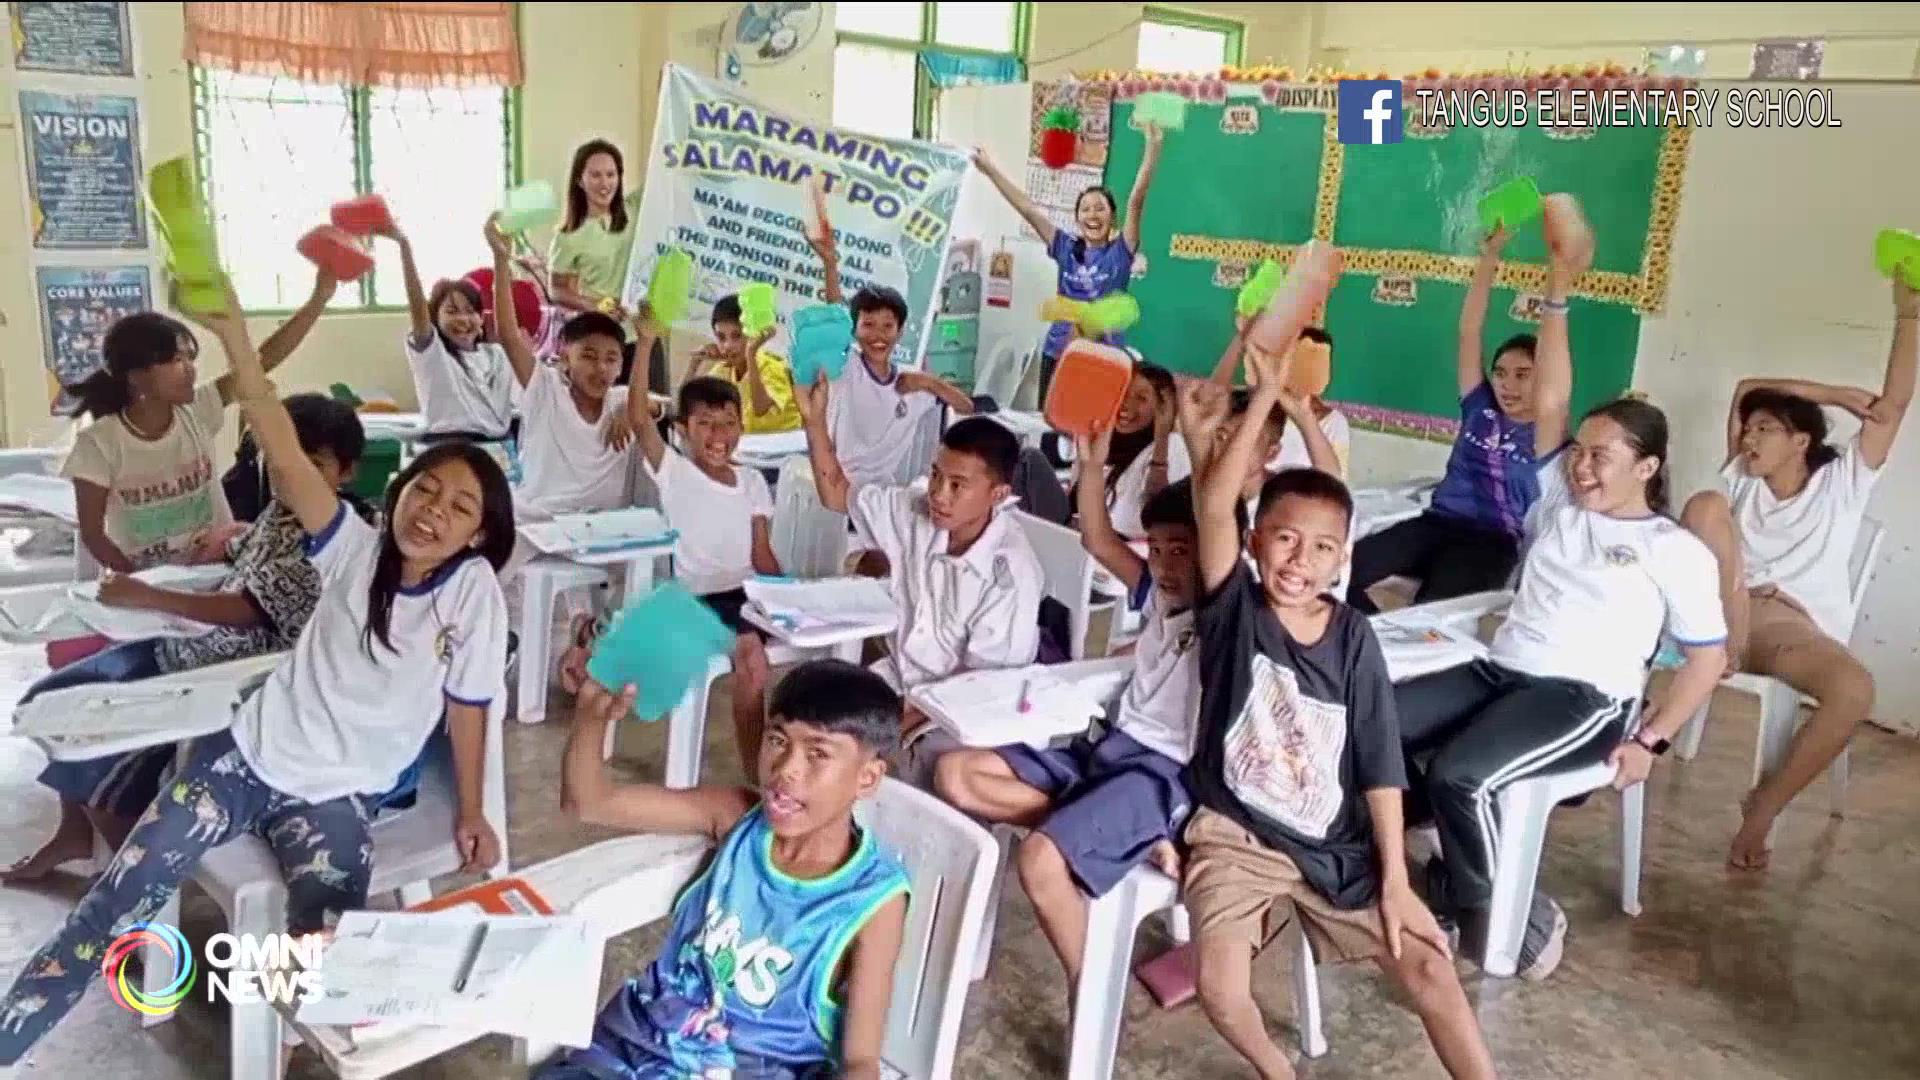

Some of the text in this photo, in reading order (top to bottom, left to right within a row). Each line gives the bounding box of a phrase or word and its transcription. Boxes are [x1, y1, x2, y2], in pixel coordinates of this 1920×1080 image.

[33, 114, 128, 138] VISION
[694, 102, 929, 191] MARAMING
[663, 143, 943, 243] SALAMAT PO !!!
[692, 186, 749, 217] MA'AM
[844, 231, 892, 257] DONG
[706, 214, 742, 236] AND
[844, 254, 874, 274] ALL
[678, 225, 709, 248] THE
[712, 236, 790, 272] SPONSORS
[47, 285, 142, 299] CORE VALUES
[700, 254, 779, 287] WATCHED
[783, 278, 814, 298] THE
